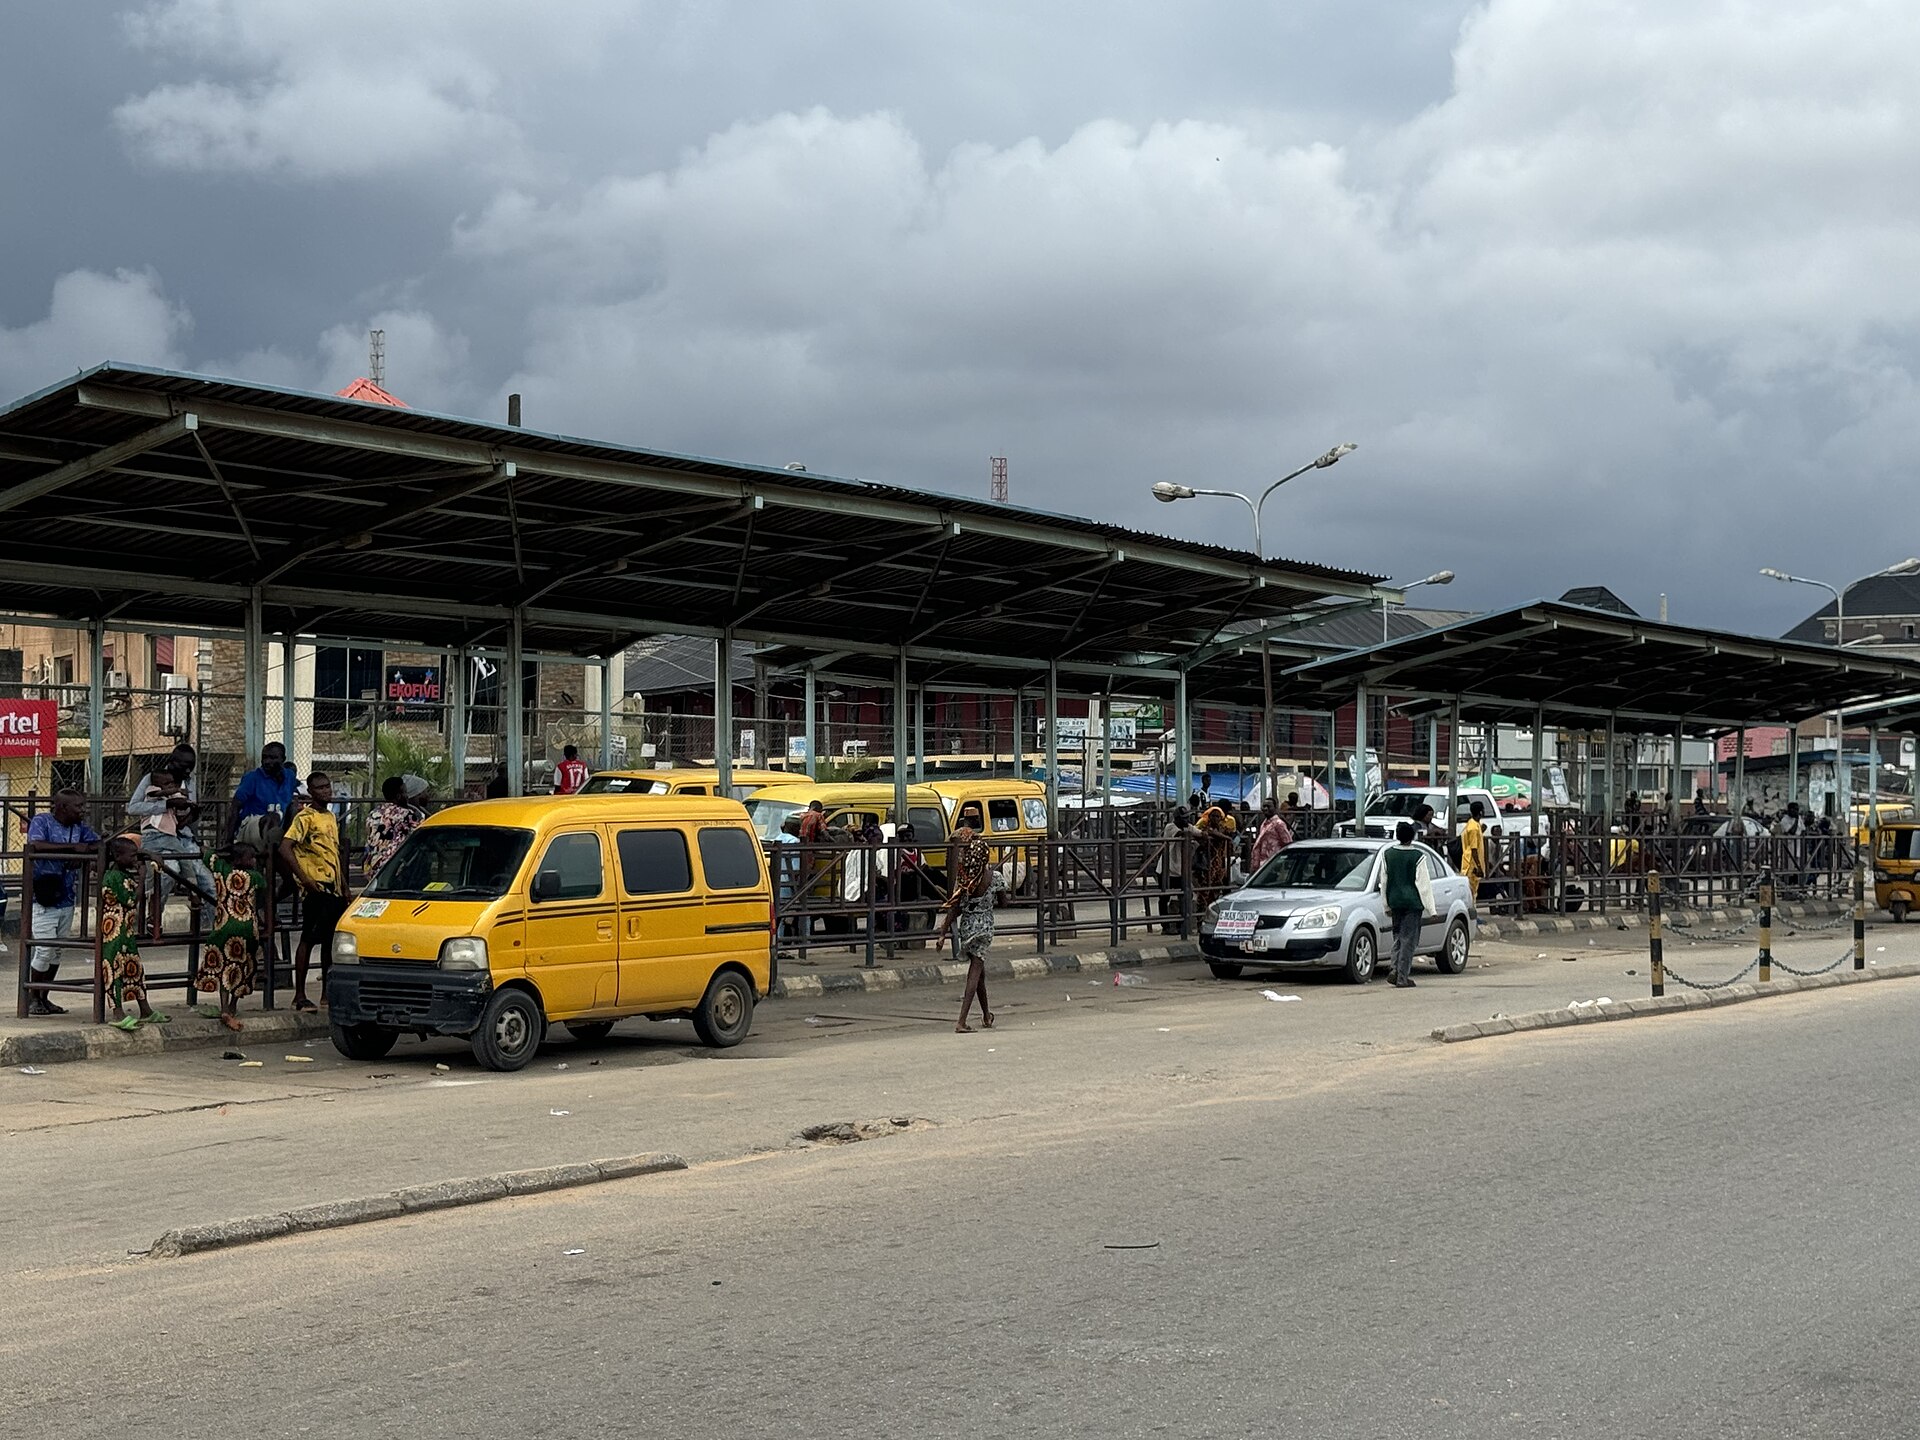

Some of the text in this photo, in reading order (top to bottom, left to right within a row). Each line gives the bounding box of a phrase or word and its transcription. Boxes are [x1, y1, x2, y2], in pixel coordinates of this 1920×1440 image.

[388, 683, 439, 698] EKOFIVE
[4, 738, 41, 746] IMAGINE
[568, 768, 584, 788] 17
